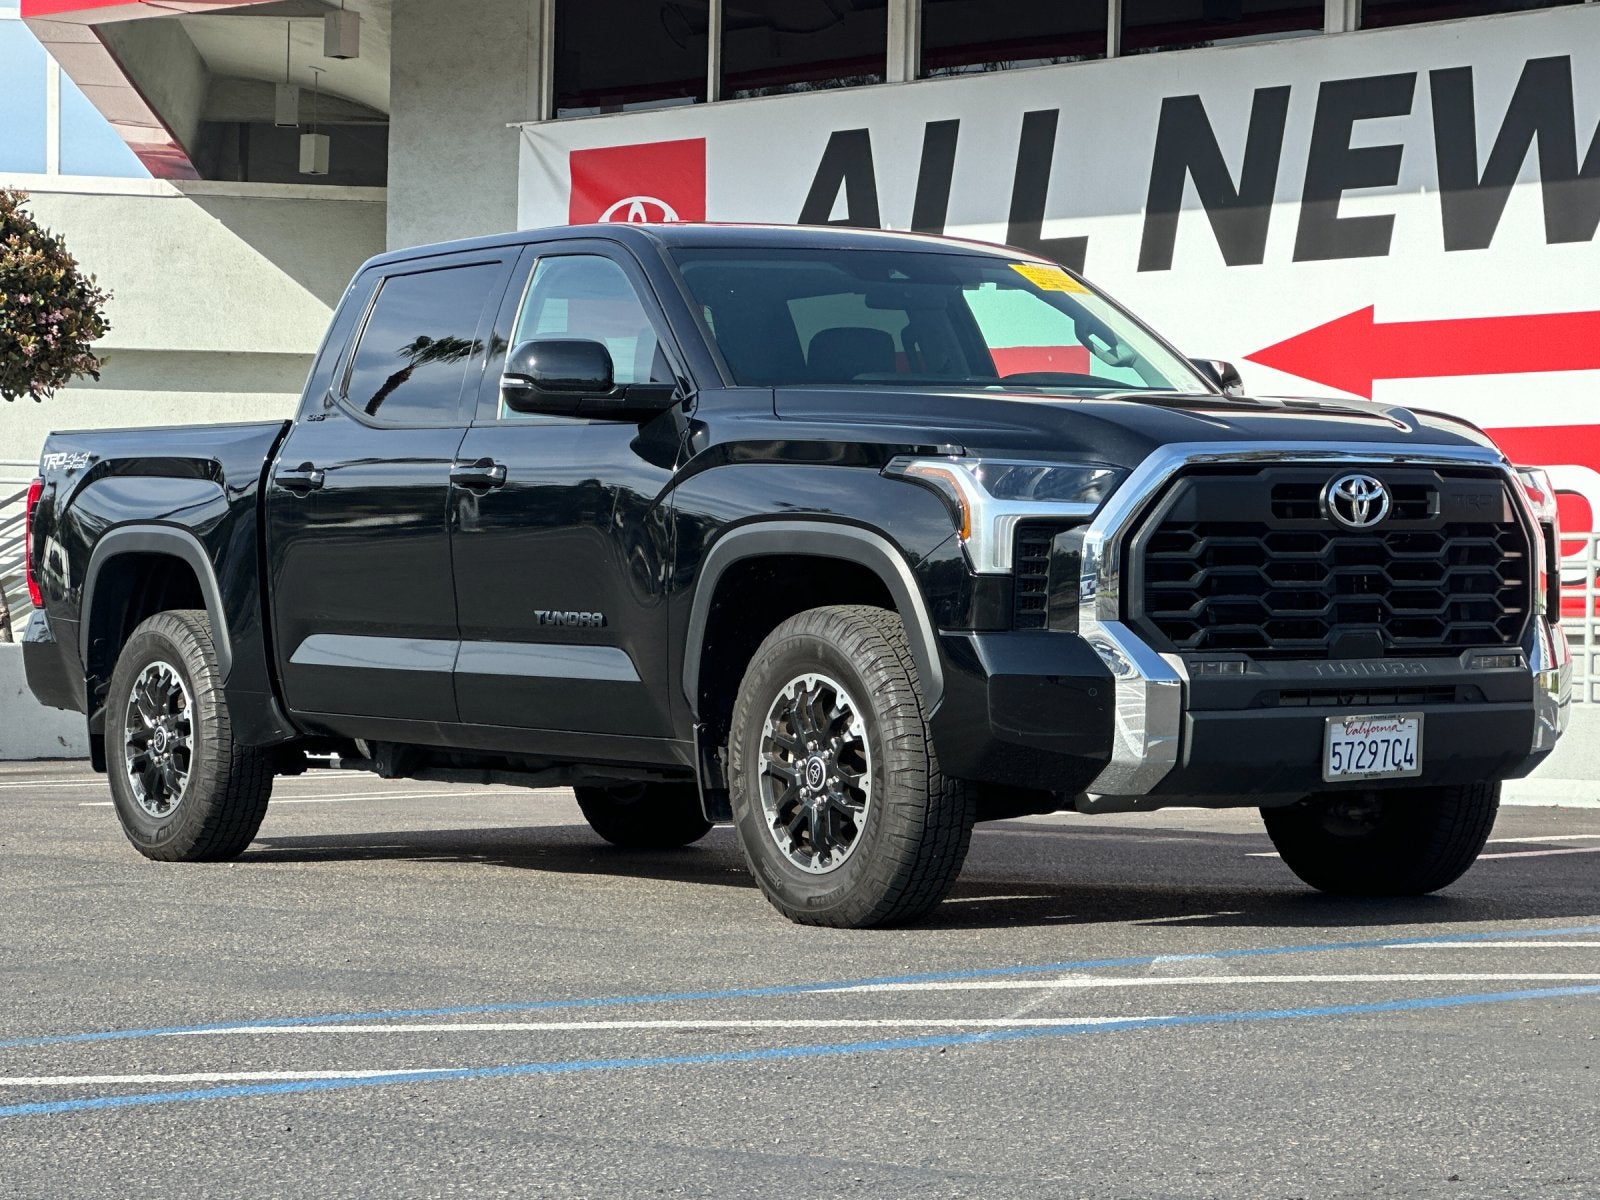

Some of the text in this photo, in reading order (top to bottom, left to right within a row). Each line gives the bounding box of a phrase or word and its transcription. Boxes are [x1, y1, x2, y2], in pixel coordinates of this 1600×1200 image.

[1137, 55, 1600, 272] NEW
[43, 452, 68, 470] TRD
[533, 610, 606, 627] TUNDRA
[1311, 661, 1429, 678] TUNDRA
[1344, 720, 1404, 739] California
[1332, 737, 1414, 771] 57297C4
